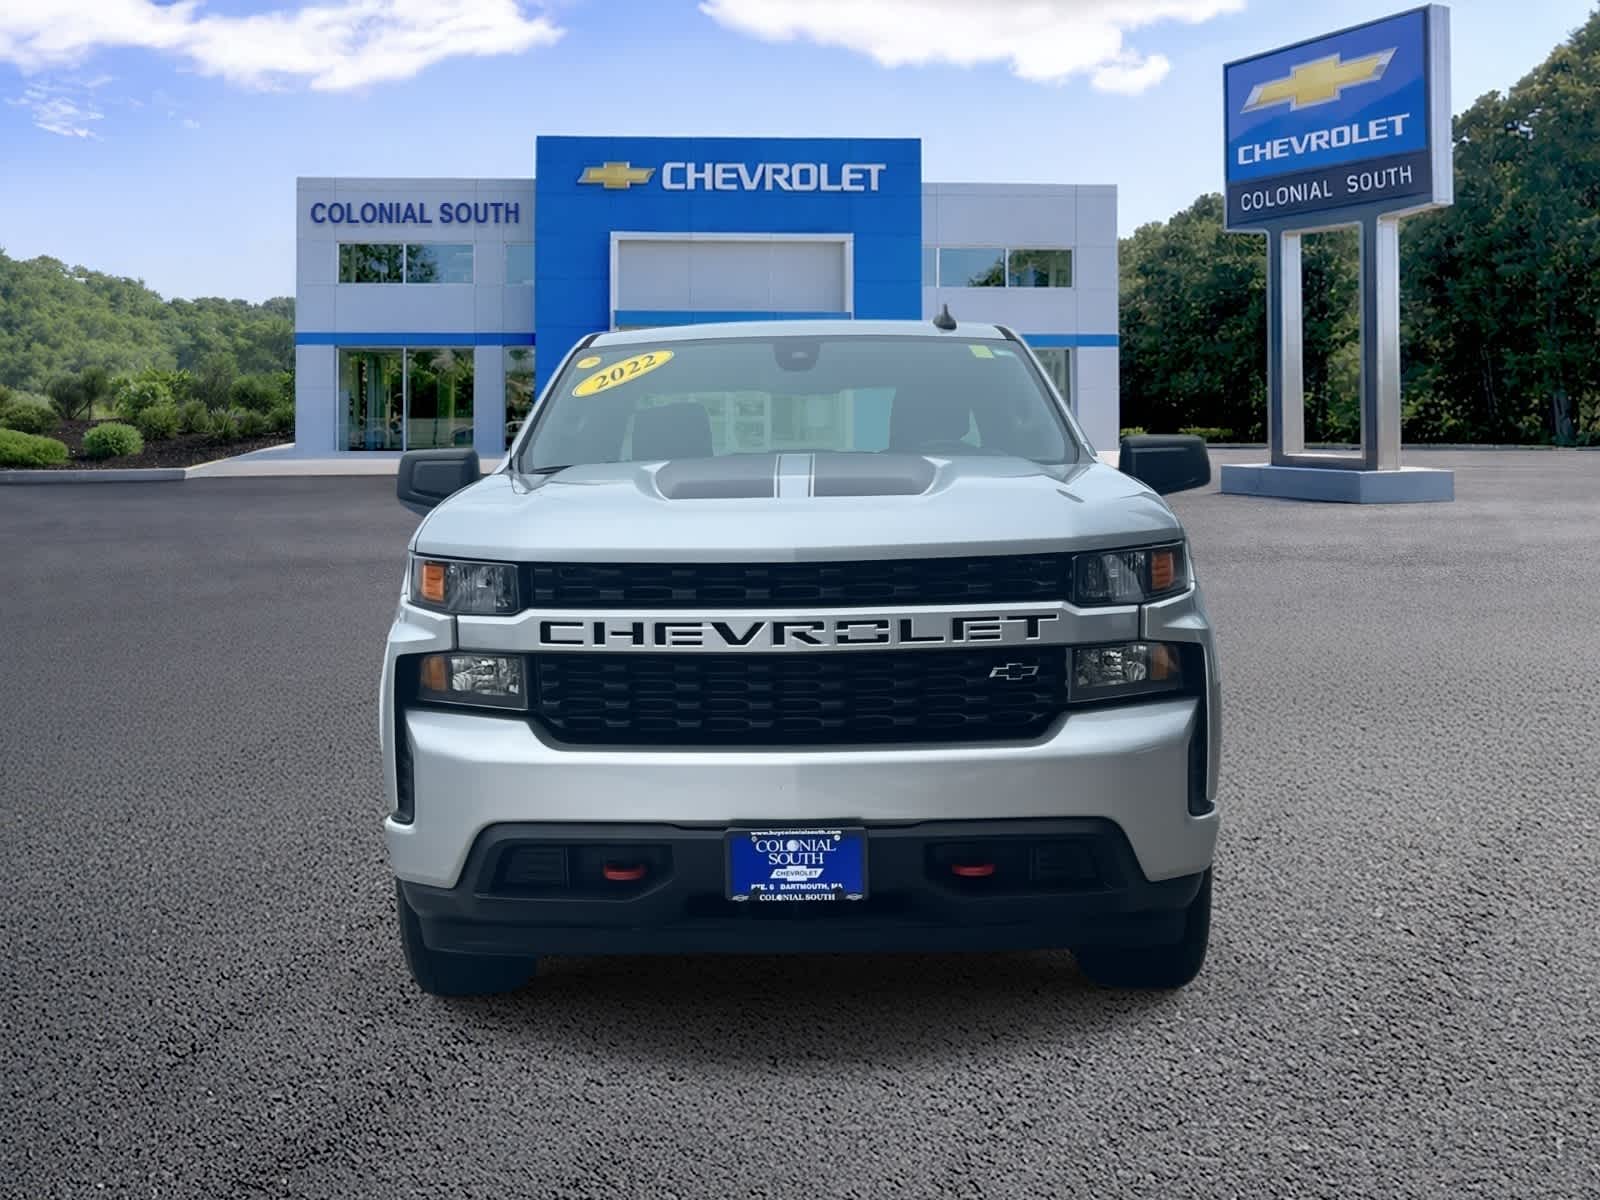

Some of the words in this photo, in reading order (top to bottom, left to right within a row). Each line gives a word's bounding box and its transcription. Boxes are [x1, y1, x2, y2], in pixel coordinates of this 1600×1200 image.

[1237, 113, 1410, 165] CHEVROLET
[661, 162, 887, 192] CHEVROLET
[1240, 180, 1333, 212] COLONIAL
[1346, 164, 1413, 194] SOUTH
[310, 202, 433, 224] COLONIAL
[439, 202, 520, 224] SOUTH
[594, 354, 657, 390] 2022
[538, 613, 1060, 647] CHEVROLET
[755, 839, 837, 853] COLONIAL
[768, 853, 824, 865] SOUTH
[759, 893, 804, 901] COLONIAL
[805, 893, 836, 901] SOUTH
